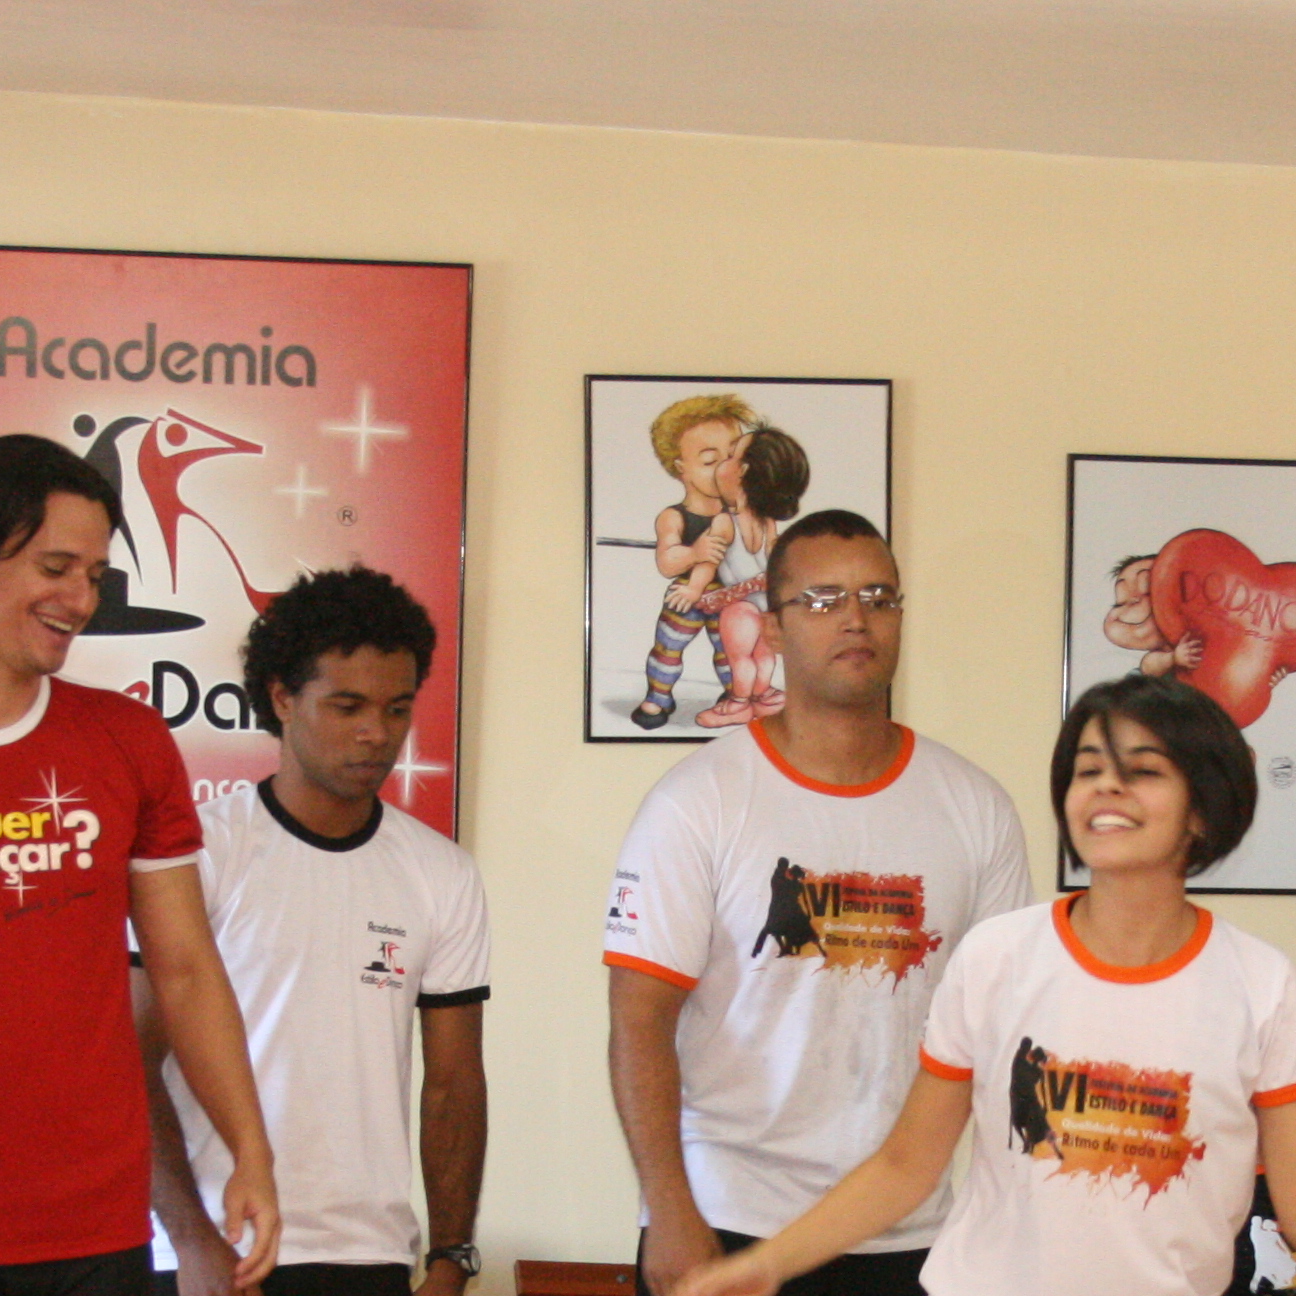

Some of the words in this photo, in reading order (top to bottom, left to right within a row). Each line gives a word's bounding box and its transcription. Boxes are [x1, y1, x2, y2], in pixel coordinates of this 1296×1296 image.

[806, 882, 840, 917] VI
[1047, 1070, 1087, 1114] VI
[1062, 1132, 1100, 1151] Ritmo
[1103, 1137, 1119, 1153] de
[1124, 1144, 1156, 1159] cada
